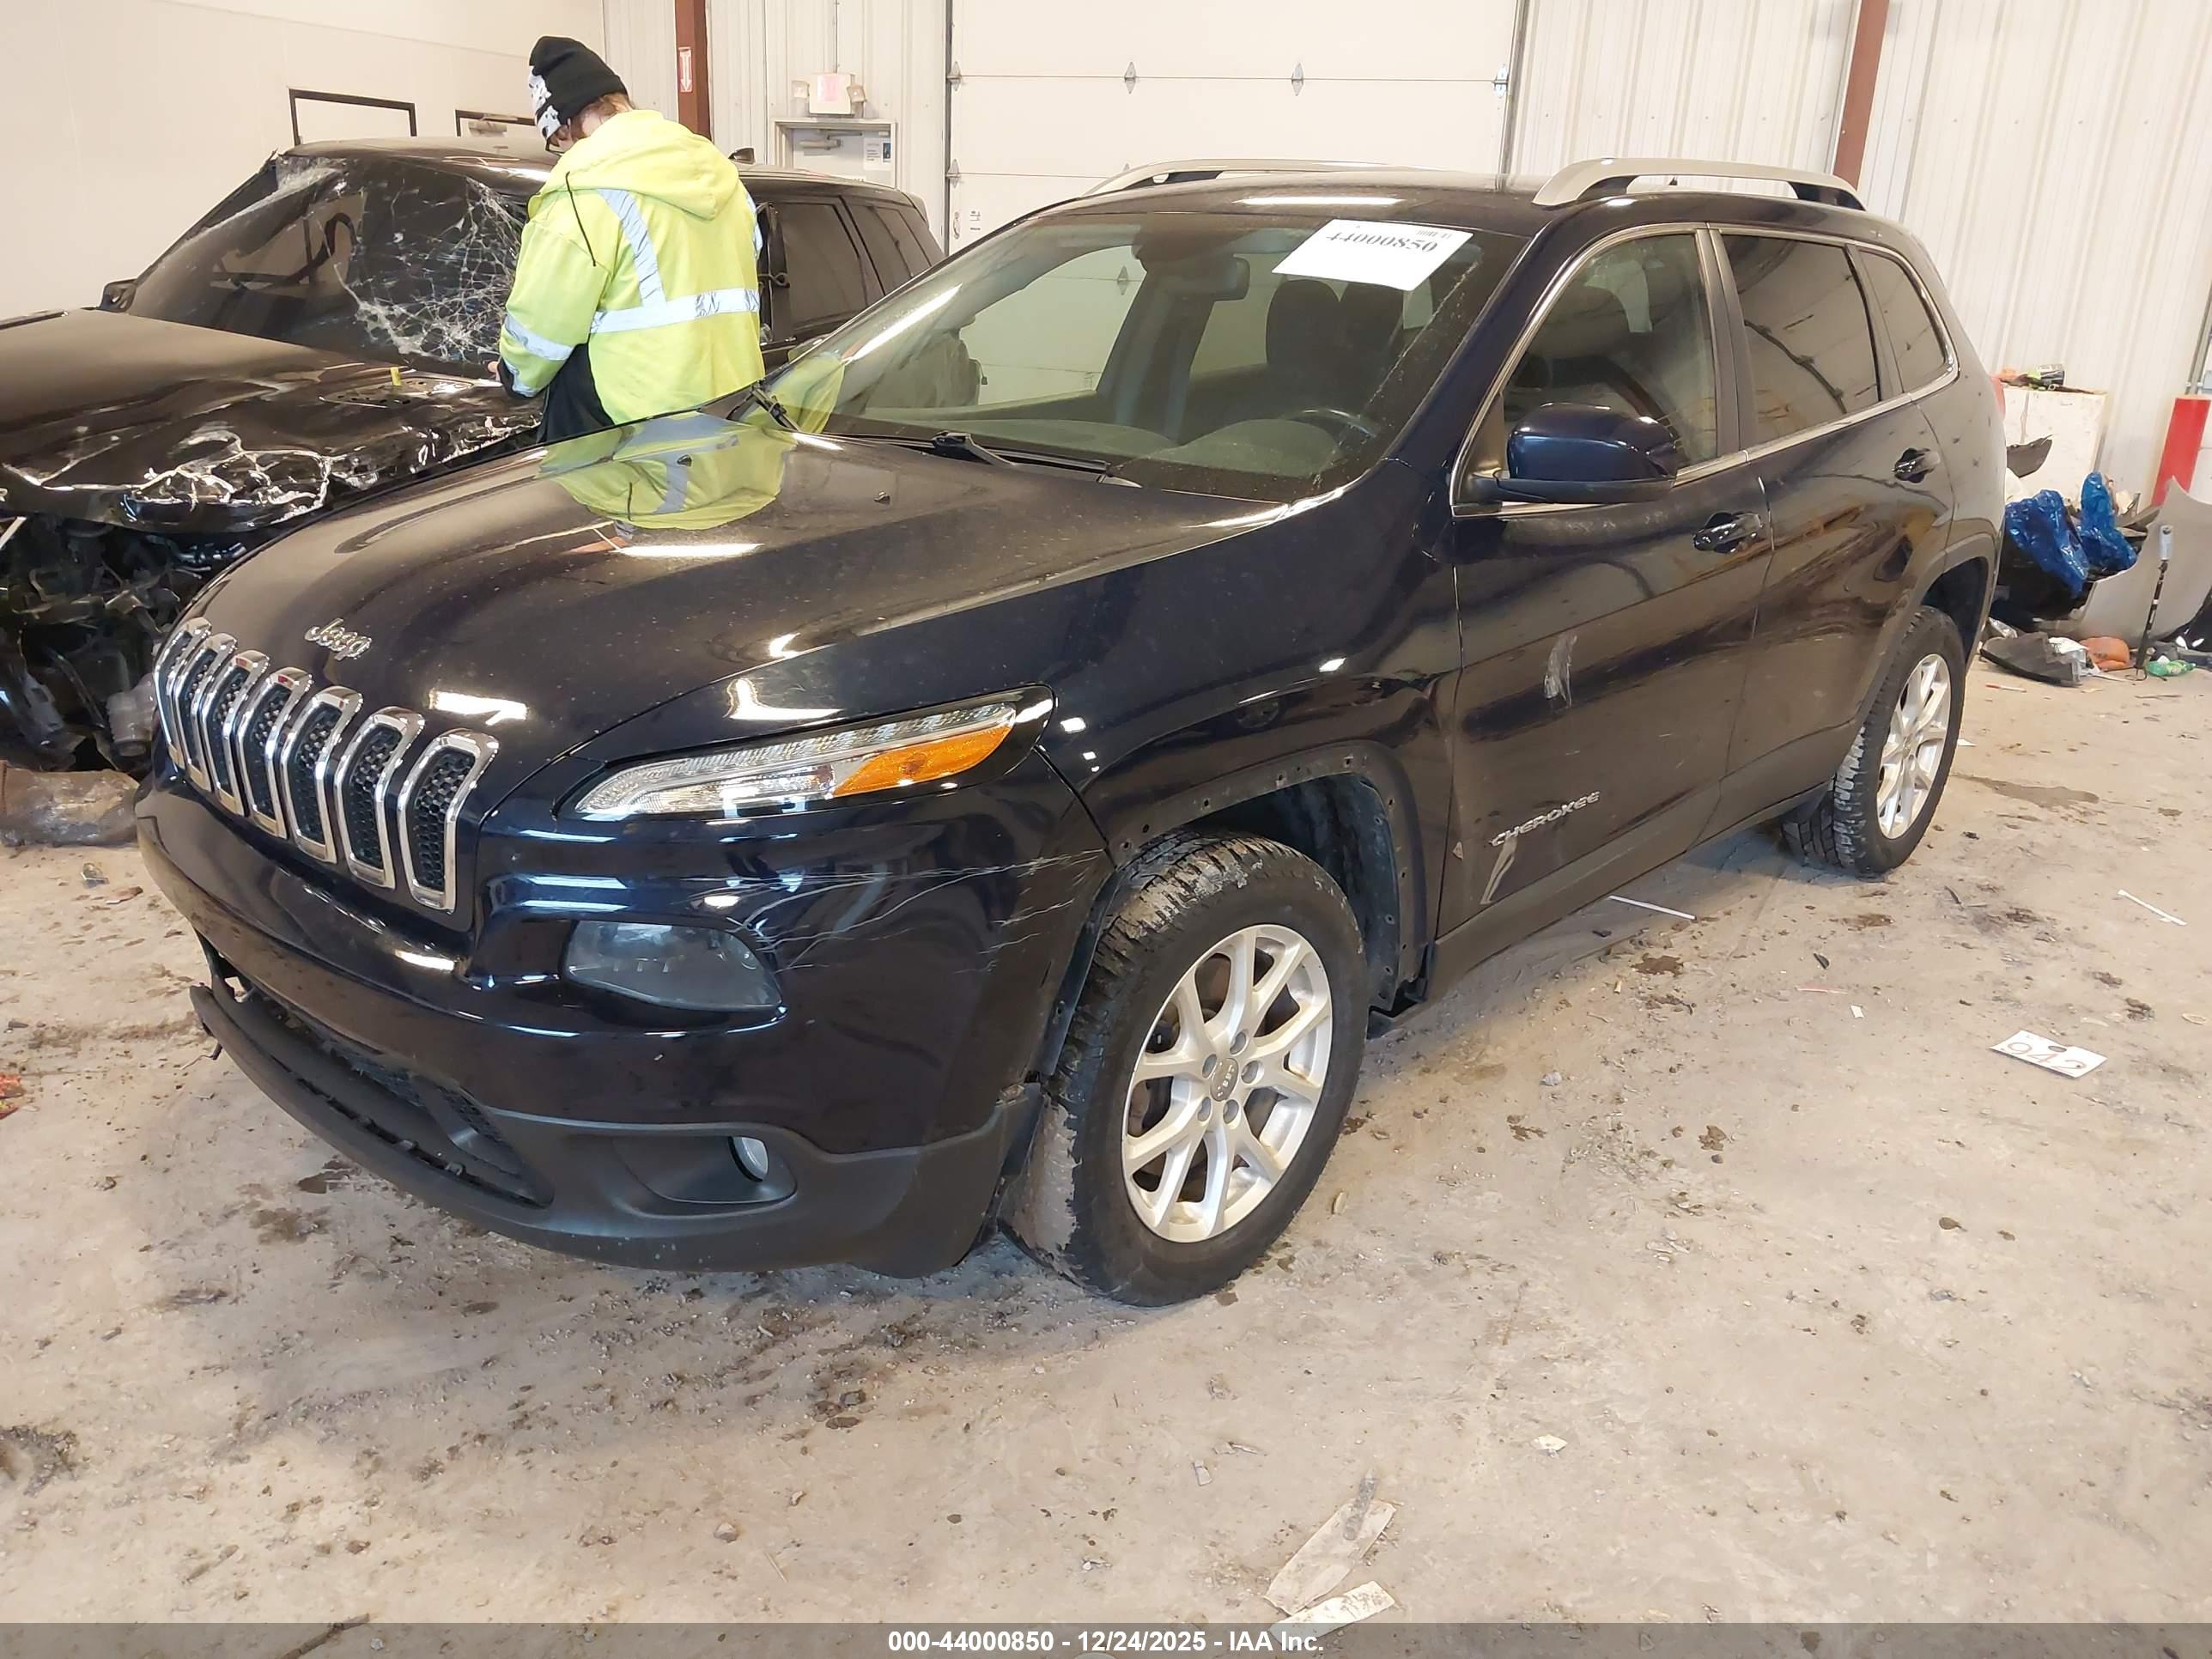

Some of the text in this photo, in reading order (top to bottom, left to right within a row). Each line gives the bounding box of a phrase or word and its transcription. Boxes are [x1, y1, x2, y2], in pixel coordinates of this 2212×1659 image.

[1326, 231, 1438, 253] 44000850
[304, 617, 373, 661] Jeep
[1488, 790, 1601, 847] CHEROKEE
